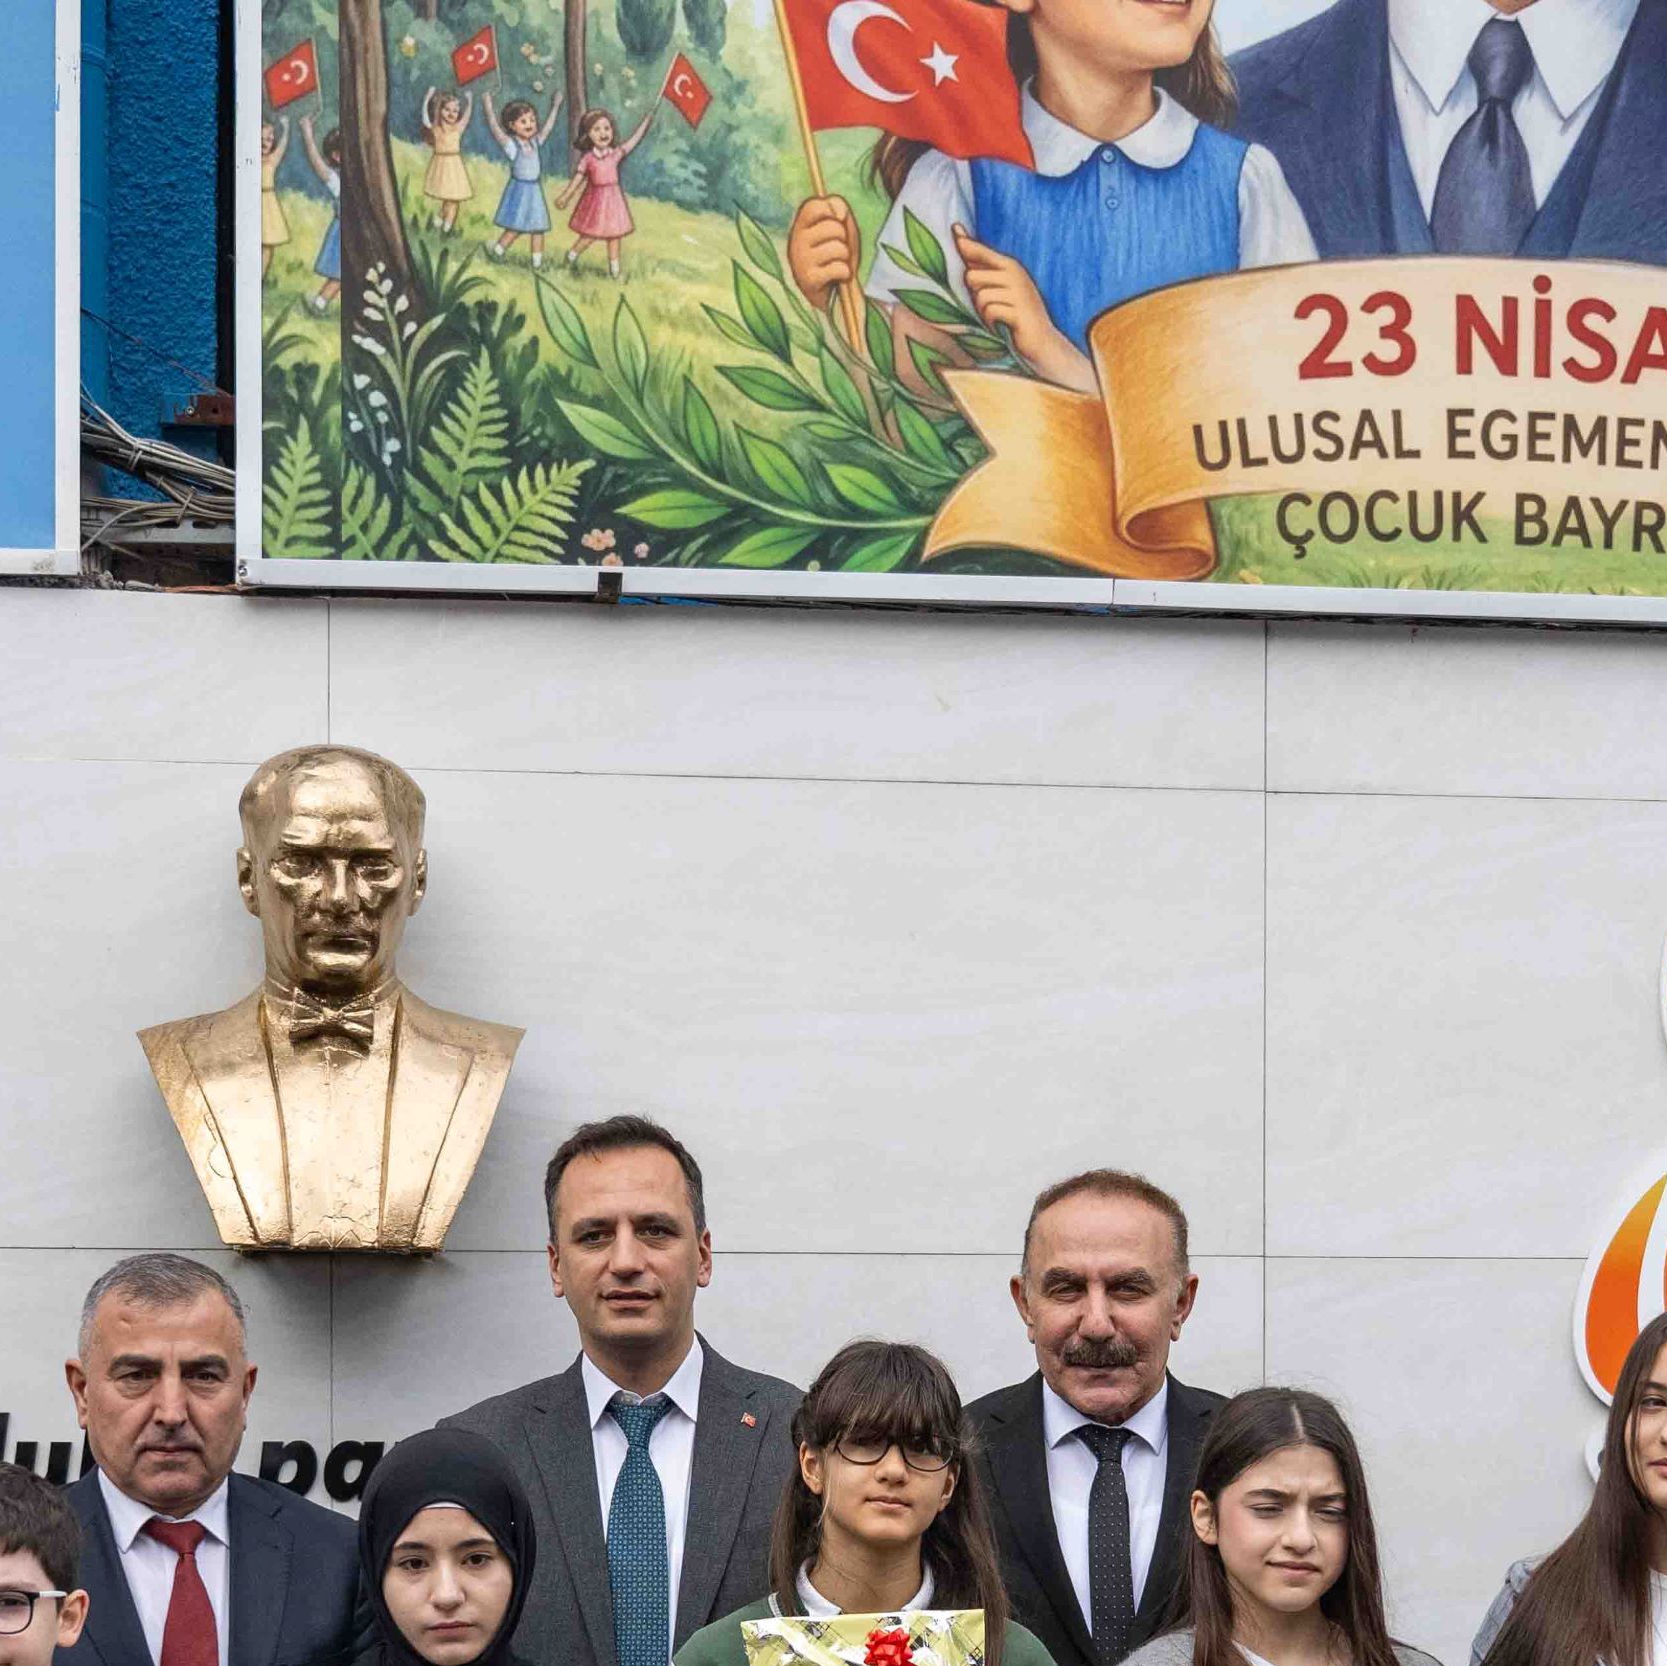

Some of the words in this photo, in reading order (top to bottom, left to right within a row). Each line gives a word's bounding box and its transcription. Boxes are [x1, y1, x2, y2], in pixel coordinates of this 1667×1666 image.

[1293, 292, 1418, 380] 23
[1193, 408, 1422, 473] ULUSAL
[1275, 490, 1487, 560] ÇOCUK
